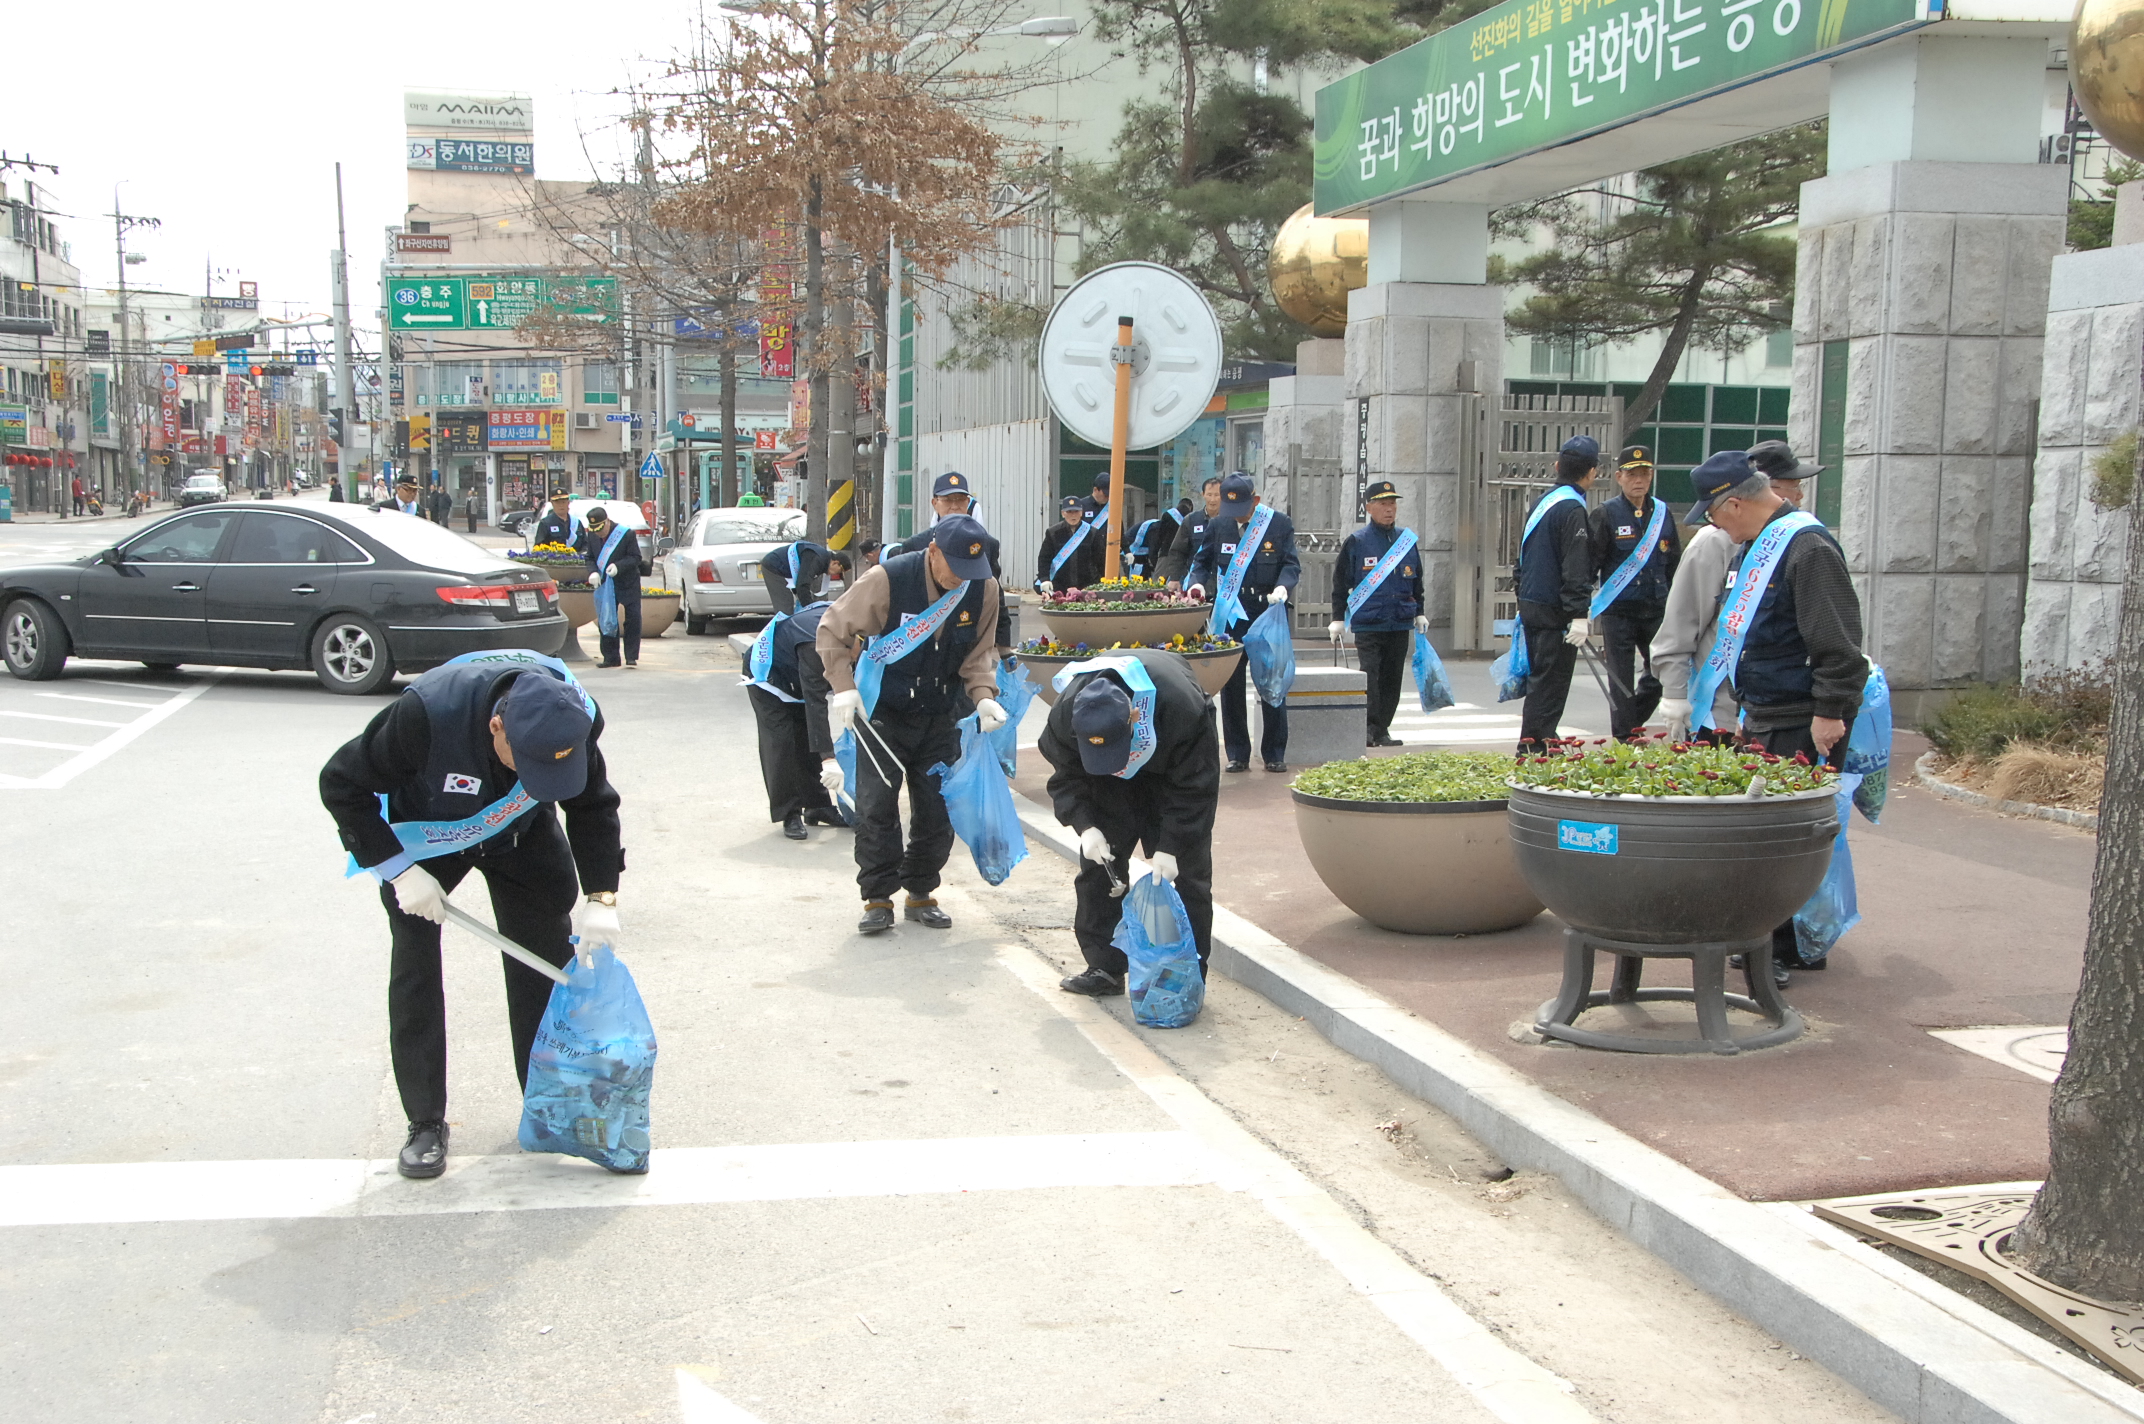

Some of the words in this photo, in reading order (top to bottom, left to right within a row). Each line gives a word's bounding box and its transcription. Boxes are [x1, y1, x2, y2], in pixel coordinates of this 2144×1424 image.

[1470, 9, 1521, 62] 선진화의
[1526, 0, 1554, 38] 길을
[1357, 106, 1403, 181] 꿈과
[1410, 72, 1485, 161] 희망의
[1494, 43, 1553, 128] 도시
[1567, 0, 1707, 107] 변화하는
[439, 141, 531, 165] 동서한의원
[399, 291, 415, 303] 36
[420, 285, 452, 299] 충주
[471, 285, 493, 297] 592
[491, 412, 535, 424] 증평도장
[1234, 526, 1260, 568] 625참전
[1221, 568, 1241, 601] 유공자회
[906, 594, 958, 642] 625참전
[868, 636, 905, 664] 유공자회
[420, 823, 483, 846] 유공자회
